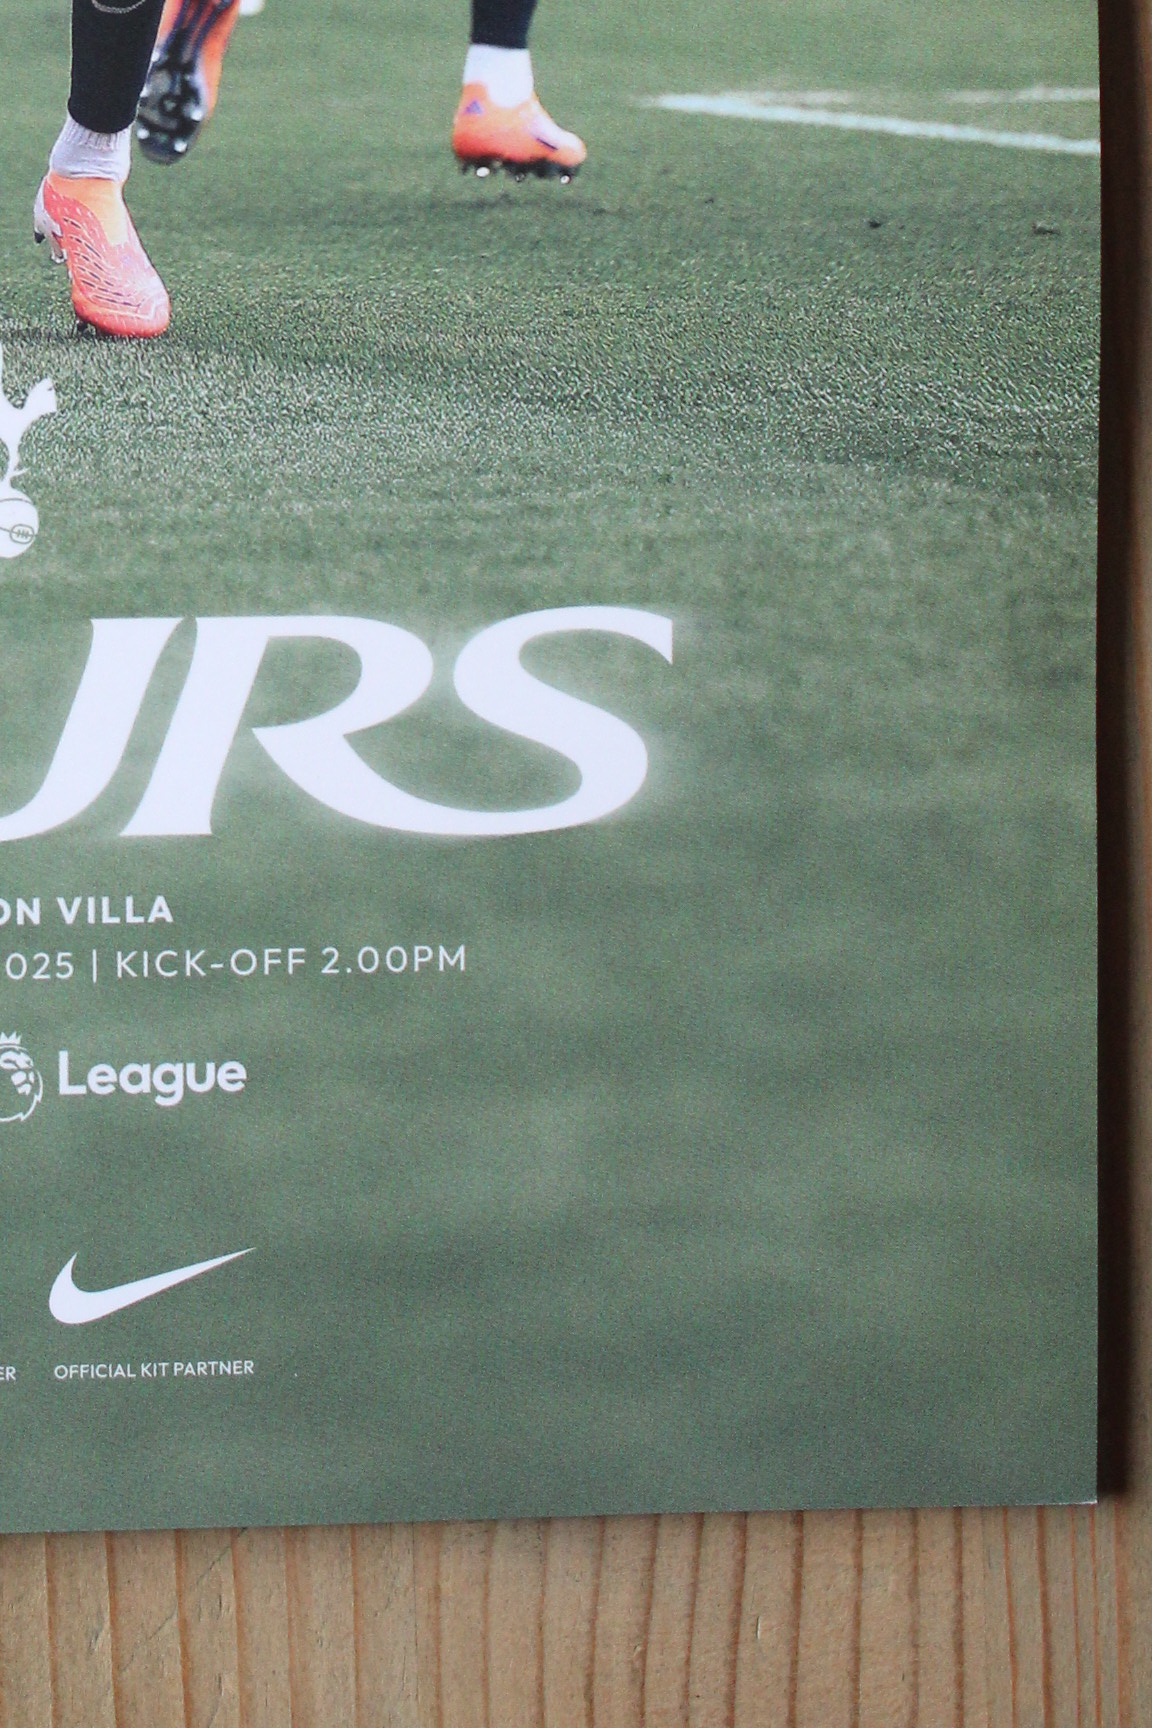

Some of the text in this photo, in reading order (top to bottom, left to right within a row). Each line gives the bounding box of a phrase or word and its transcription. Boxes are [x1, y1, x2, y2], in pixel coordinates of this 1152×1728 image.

[56, 895, 174, 925] VILLA
[116, 947, 306, 979] KICK-OFF
[321, 944, 466, 976] 2.00PM
[58, 1050, 247, 1107] League
[53, 1360, 255, 1380] OFFICIAL KIT PARTNER
